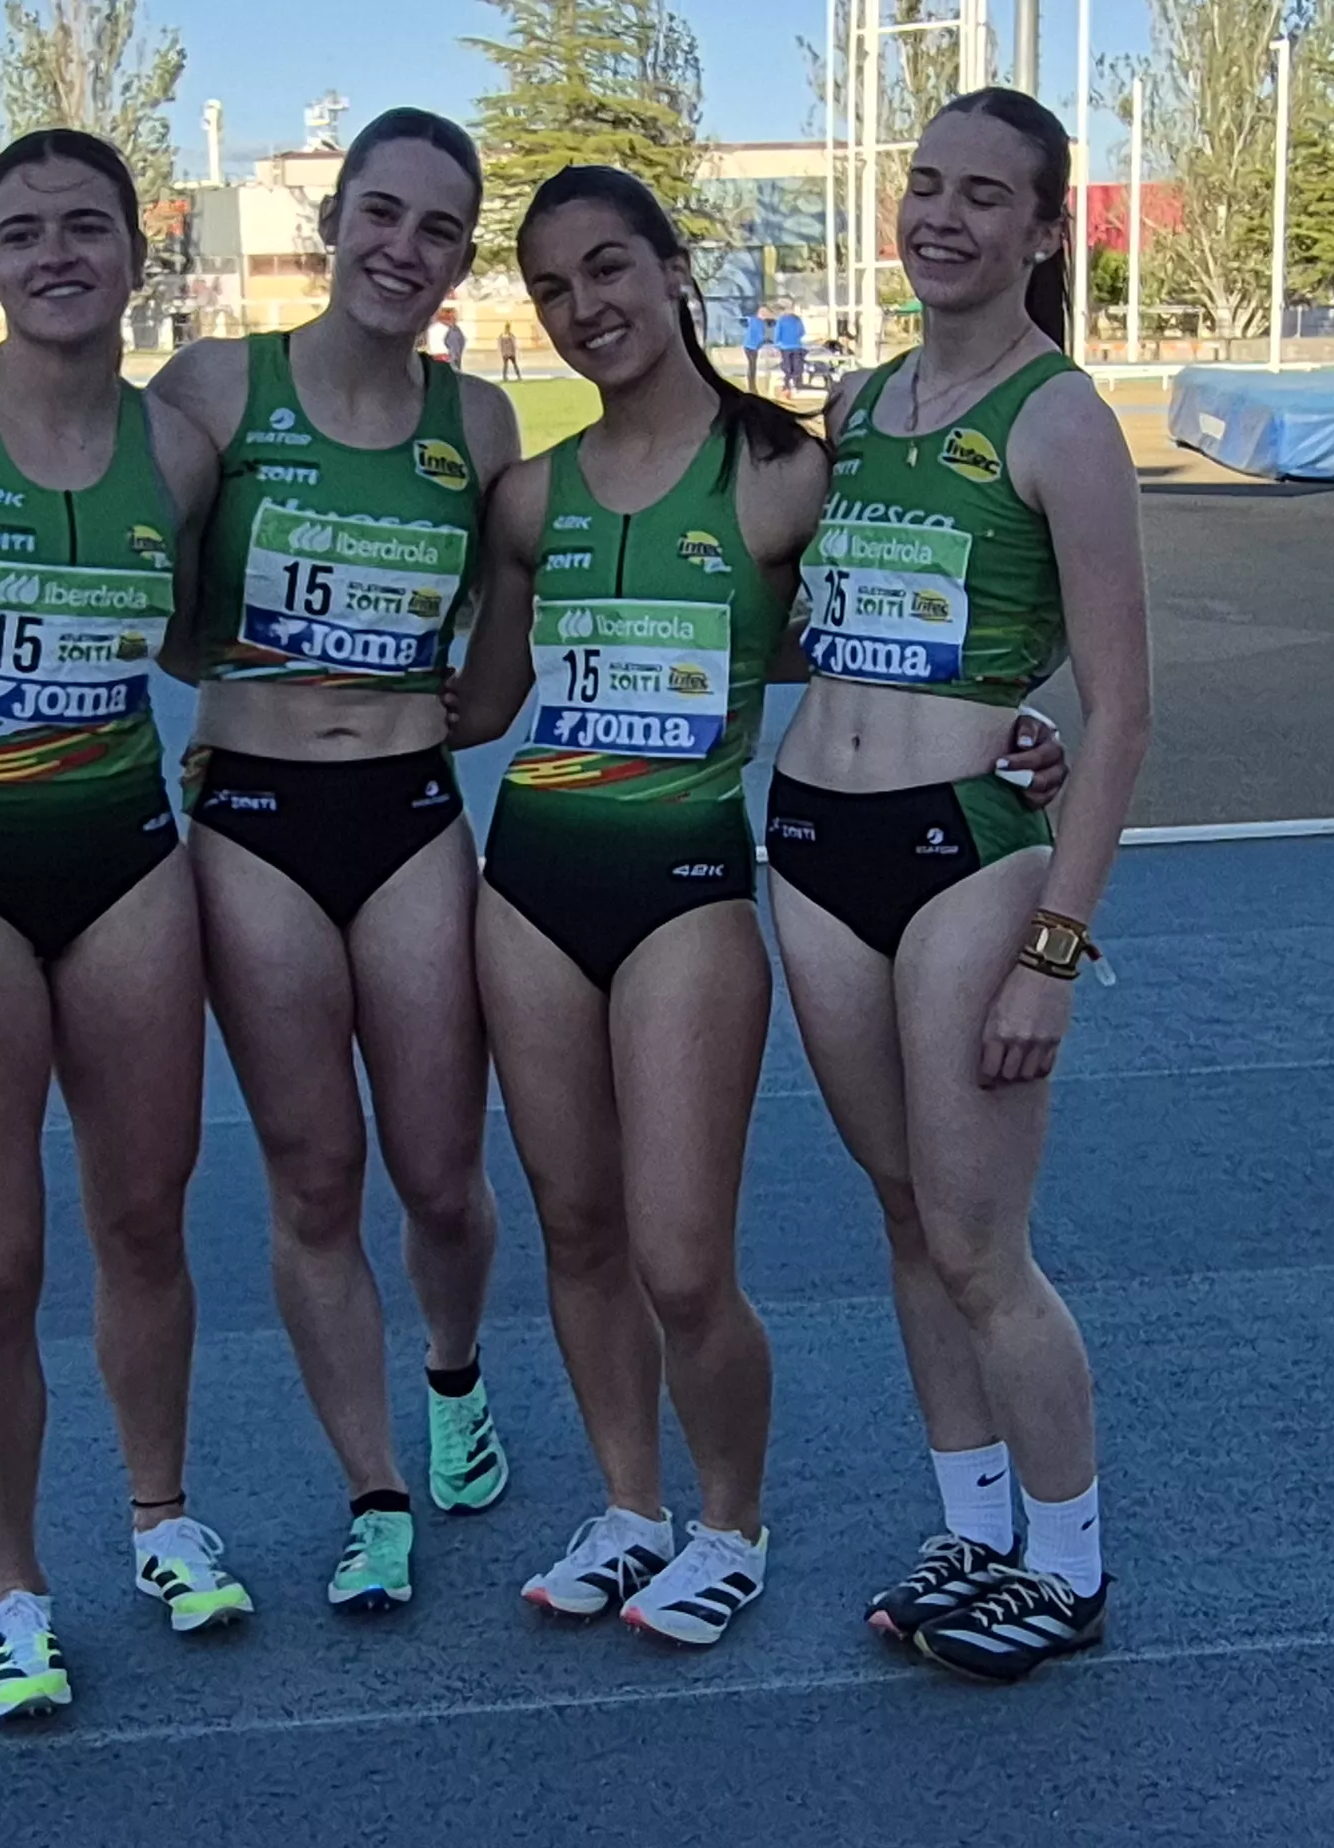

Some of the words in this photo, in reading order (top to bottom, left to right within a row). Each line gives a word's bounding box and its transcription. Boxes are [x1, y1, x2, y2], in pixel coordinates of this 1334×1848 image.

[336, 531, 439, 564] Iberdrola
[851, 534, 934, 564] Iberdrola
[44, 581, 148, 609] Iberdrola
[283, 561, 334, 617] 15
[824, 569, 851, 627] 15
[346, 593, 404, 615] ZOITI
[855, 596, 904, 618] ZOITI
[595, 614, 695, 640] Iberdrola
[57, 643, 113, 664] ZOITI
[562, 648, 601, 703] 15
[609, 673, 662, 693] ZOITI
